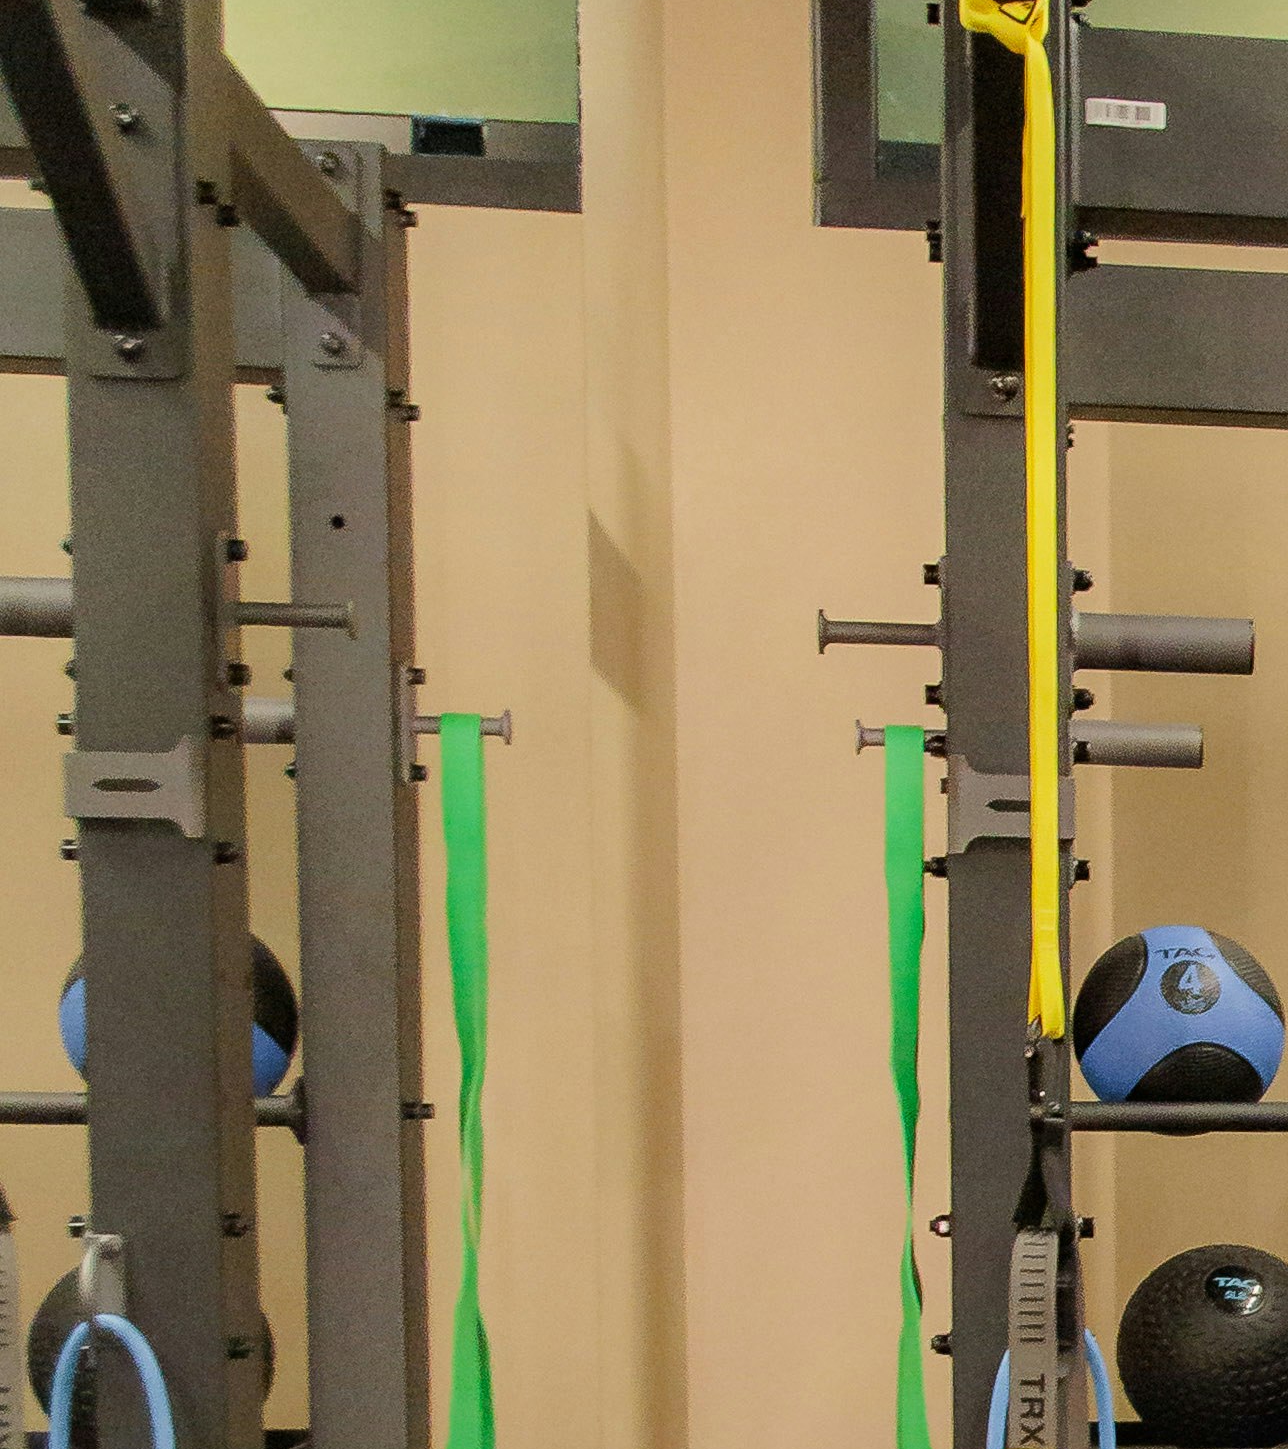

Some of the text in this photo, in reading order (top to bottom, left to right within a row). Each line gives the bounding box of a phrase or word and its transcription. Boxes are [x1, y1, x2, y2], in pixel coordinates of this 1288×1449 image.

[1177, 962, 1203, 995] 4
[1212, 1277, 1260, 1293] TAG
[1020, 1373, 1045, 1446] TRX
